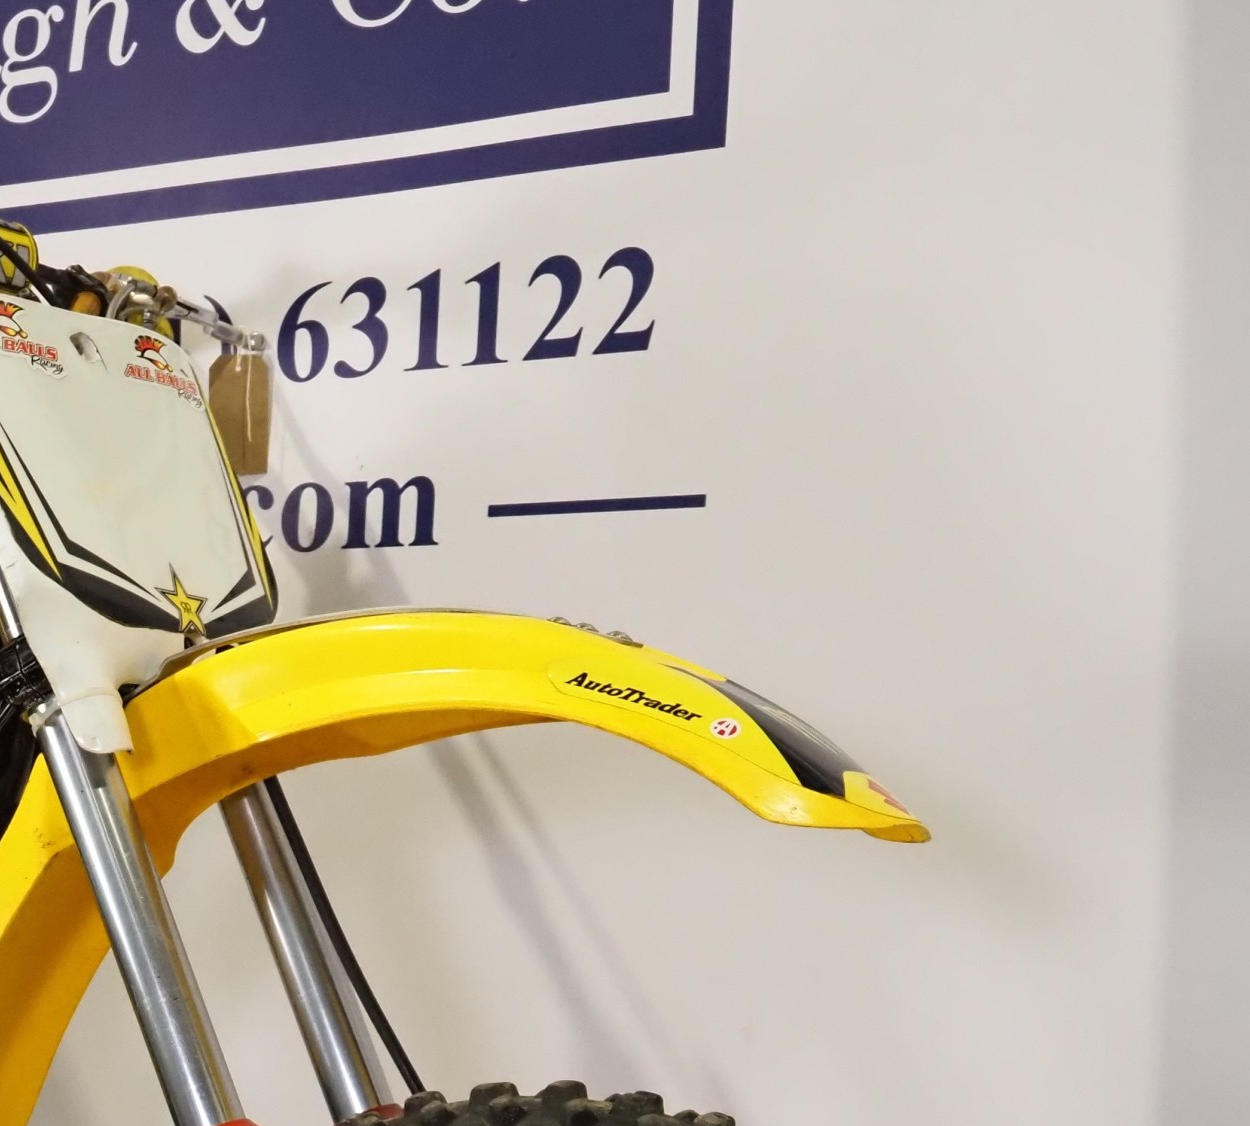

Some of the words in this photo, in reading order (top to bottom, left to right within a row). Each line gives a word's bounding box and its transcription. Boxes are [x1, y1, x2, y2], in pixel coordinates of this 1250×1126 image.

[277, 246, 656, 383] 631122
[1, 333, 59, 362] BALLS
[30, 354, 64, 375] Racing
[124, 363, 155, 384] ALL
[154, 370, 198, 396] BALLS
[564, 672, 703, 722] AutoTrader
